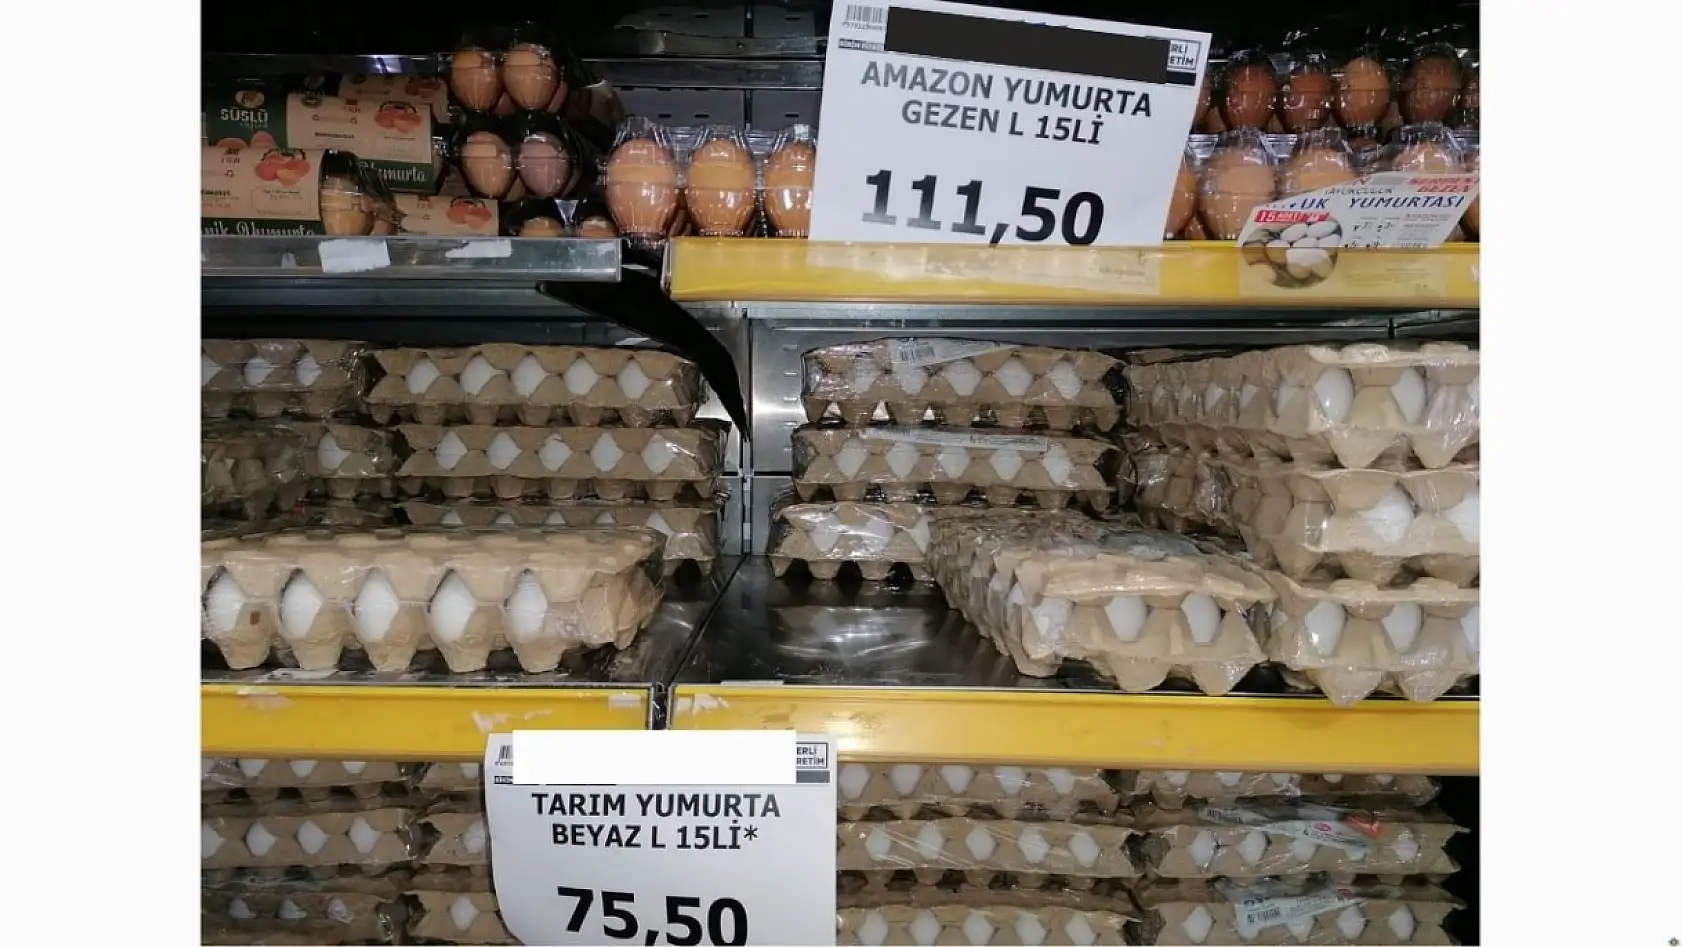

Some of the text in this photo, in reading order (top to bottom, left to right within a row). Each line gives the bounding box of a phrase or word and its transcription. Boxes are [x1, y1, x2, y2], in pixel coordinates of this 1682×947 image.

[862, 61, 1152, 117] AMAZON YUMURTA
[902, 100, 1105, 145] GEZEN L 15Lİ
[861, 169, 1105, 247] 111,50
[1348, 195, 1465, 209] YUMURTASI
[531, 792, 781, 818] TARIM YUMURTA
[552, 822, 642, 848] BEYAZ
[651, 825, 667, 849] L
[557, 885, 748, 946] 75,50
